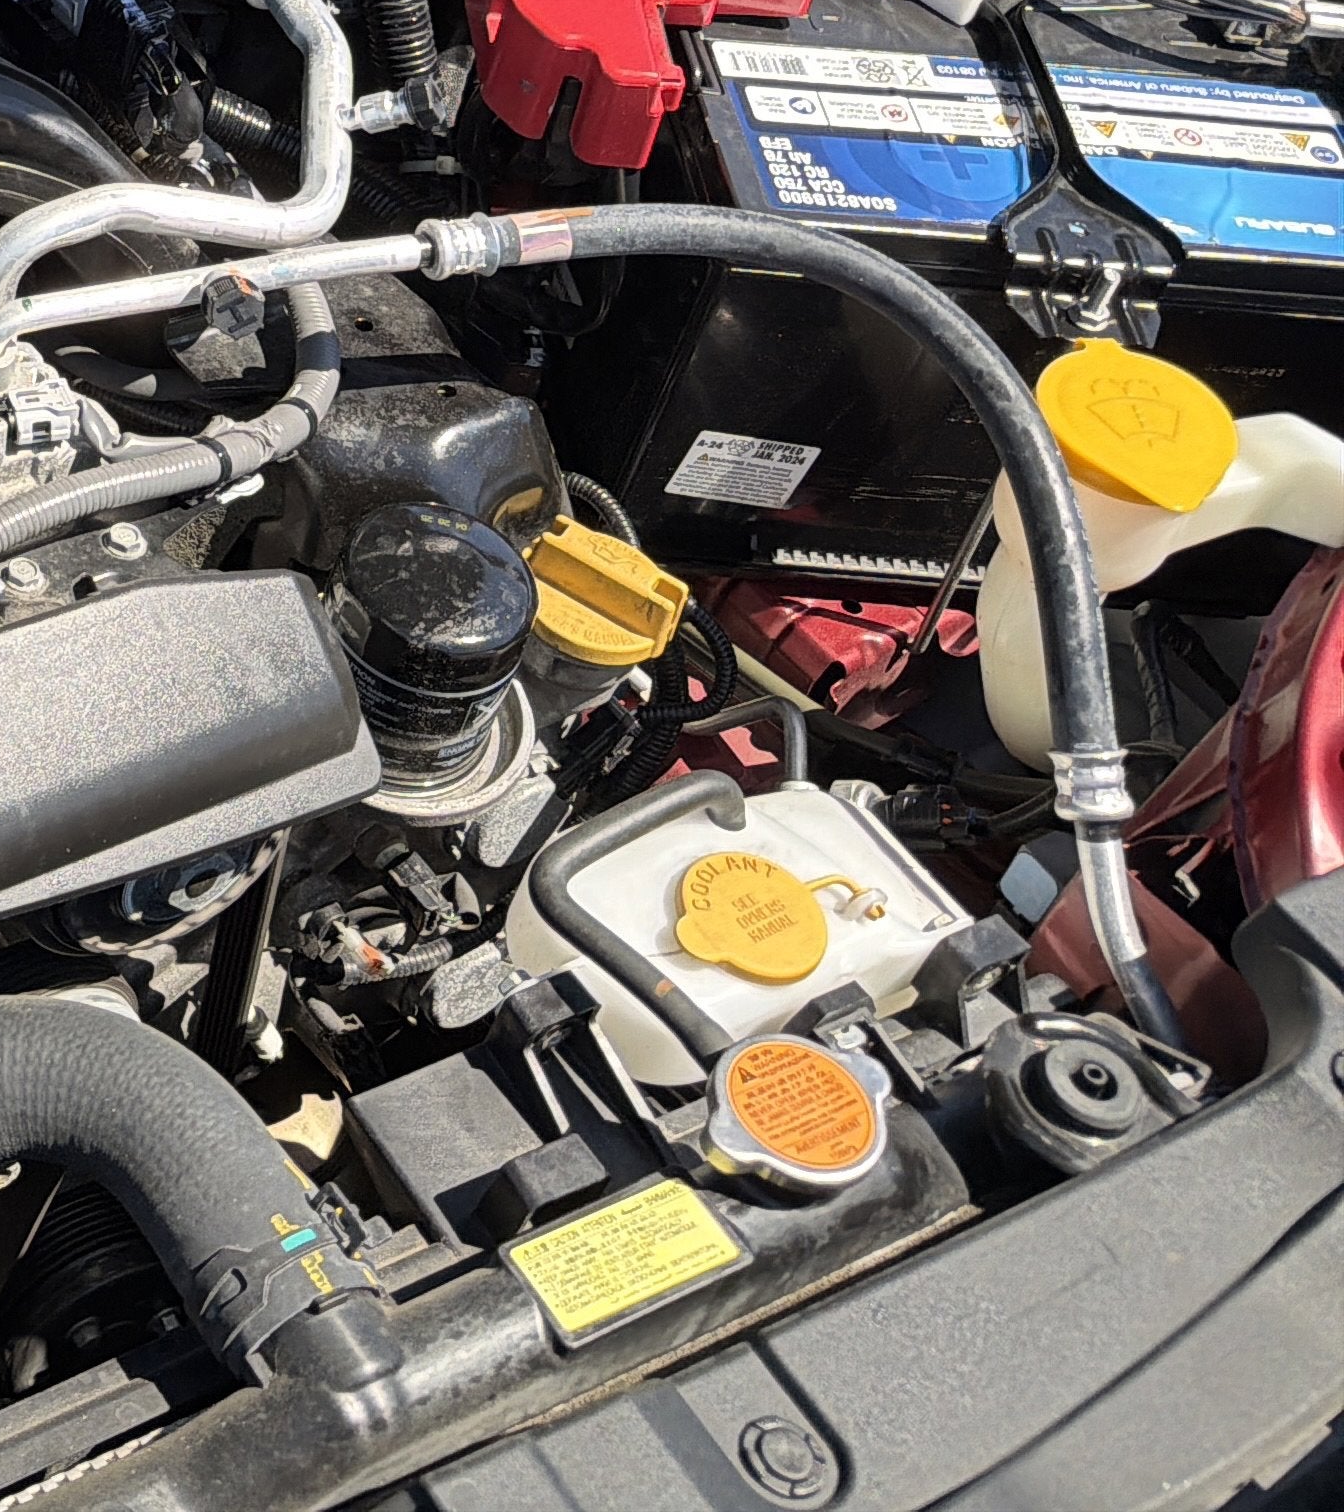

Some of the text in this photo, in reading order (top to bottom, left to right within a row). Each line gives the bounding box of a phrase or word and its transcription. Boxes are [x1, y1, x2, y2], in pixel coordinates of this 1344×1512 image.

[1145, 81, 1159, 91] of
[1160, 83, 1209, 97] Subaru
[1233, 88, 1306, 105] Distributed
[787, 151, 811, 165] Ah
[768, 163, 830, 179] RC 120
[773, 176, 846, 194] CCA 750
[1234, 216, 1336, 237] SUBARU
[696, 439, 724, 450] A-24
[757, 441, 805, 455] SHIPPED
[750, 450, 807, 466] JAN. 2024
[690, 856, 779, 911] COOLANT
